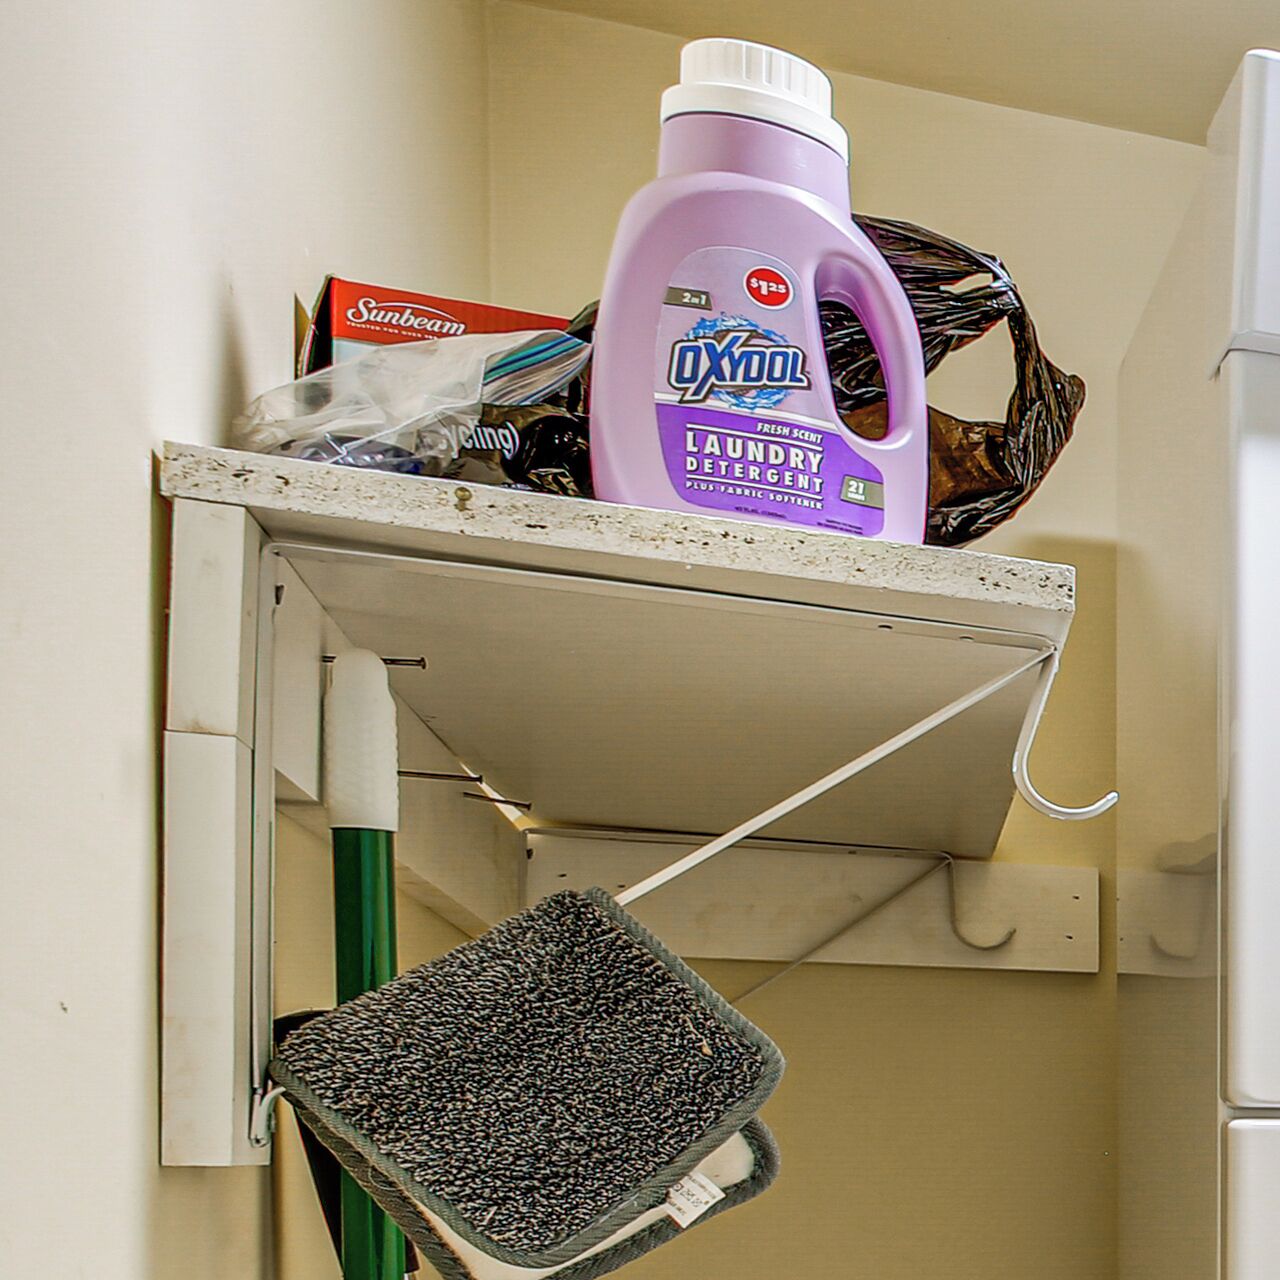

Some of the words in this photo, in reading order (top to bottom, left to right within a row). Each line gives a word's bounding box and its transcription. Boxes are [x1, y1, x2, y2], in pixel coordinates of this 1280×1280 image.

[346, 297, 467, 336] Sunbeam
[671, 332, 808, 401] OXYDOL
[757, 422, 790, 436] FRESH
[791, 428, 823, 444] SCENT
[686, 431, 823, 474] LAUNDRY
[686, 456, 823, 493] DETERGENT
[848, 480, 864, 494] 21
[686, 481, 715, 492] PLUS
[720, 485, 764, 500] FABRIC
[769, 492, 823, 510] SOFTENER
